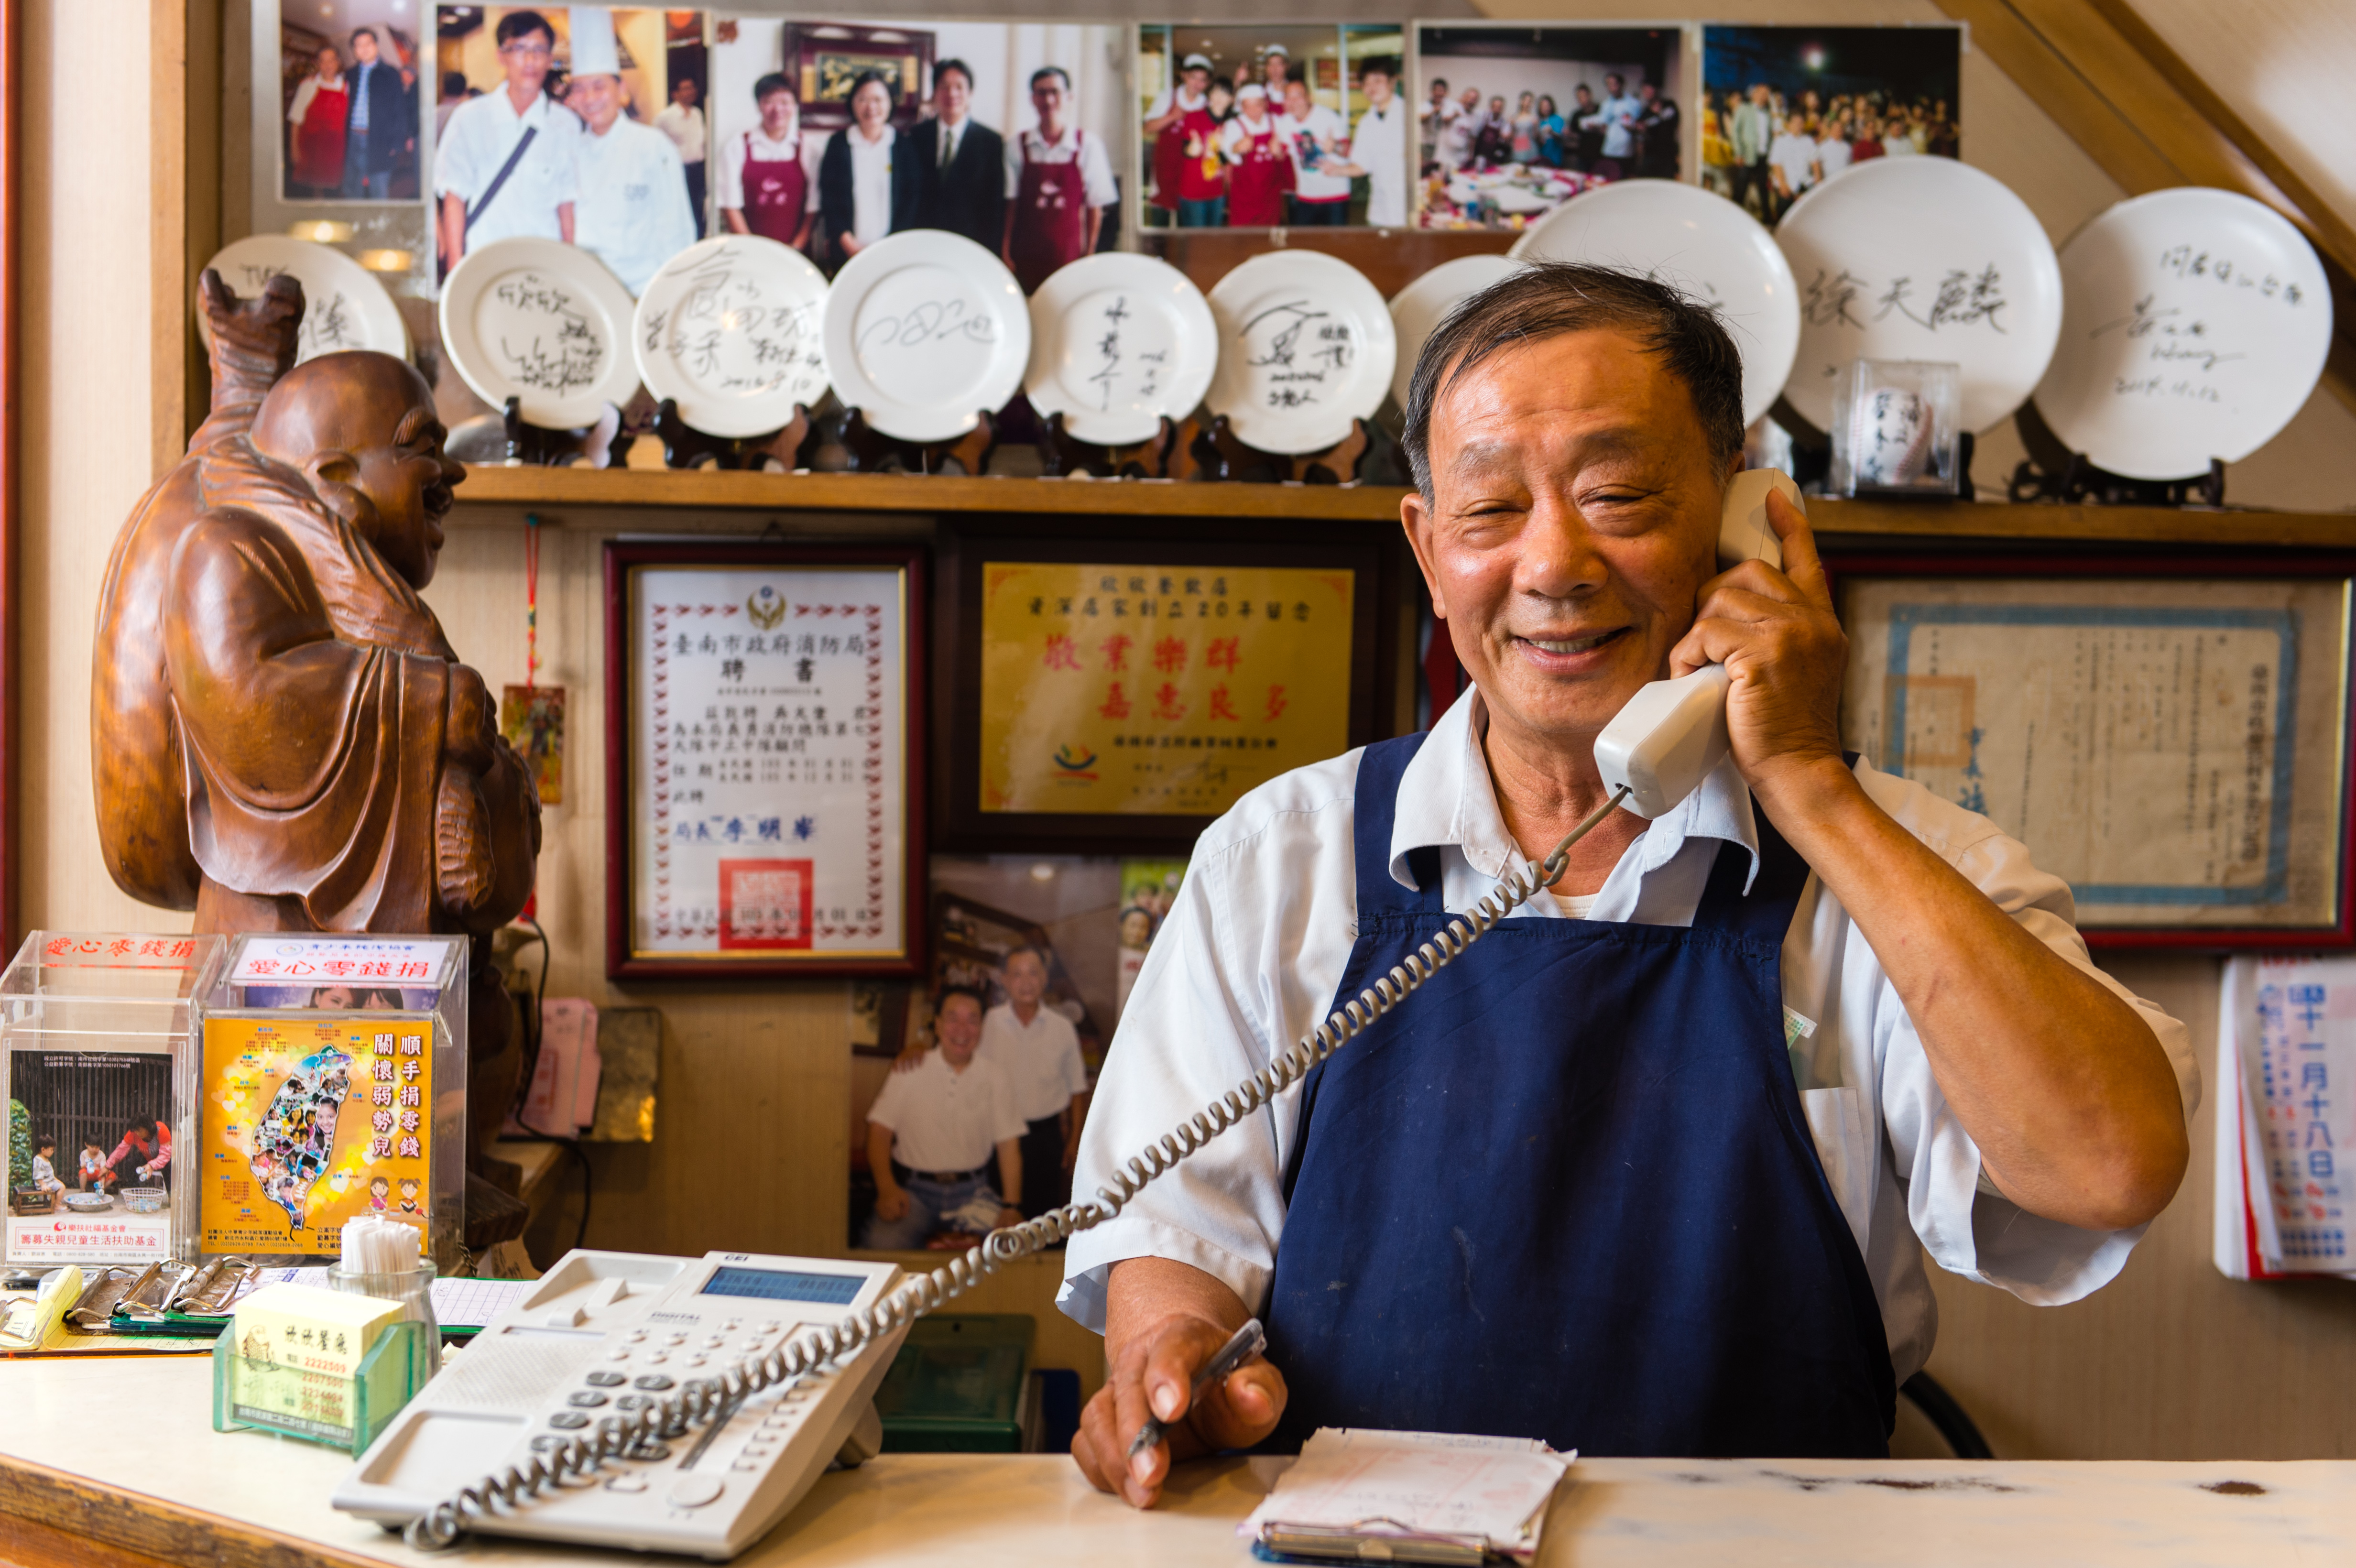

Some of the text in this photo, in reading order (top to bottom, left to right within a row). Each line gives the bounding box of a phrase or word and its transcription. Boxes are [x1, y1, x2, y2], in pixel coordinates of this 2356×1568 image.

[673, 632, 864, 657] 臺南市政府消防局
[1043, 632, 1242, 674] 敬業樂群
[721, 657, 814, 683] 聘書
[1097, 681, 1288, 722] 嘉惠良多
[44, 937, 197, 958] 愛心零錢捐
[246, 959, 429, 978] 愛心零錢捐
[371, 1033, 394, 1157] 關懷弱勢兒
[398, 1034, 422, 1158] 順手捐零錢
[21, 1234, 157, 1247] 籌募失親兒童生活扶助基金
[68, 1224, 127, 1232] 樂扶社福基金會
[285, 1325, 348, 1355] 欣欣餐廳
